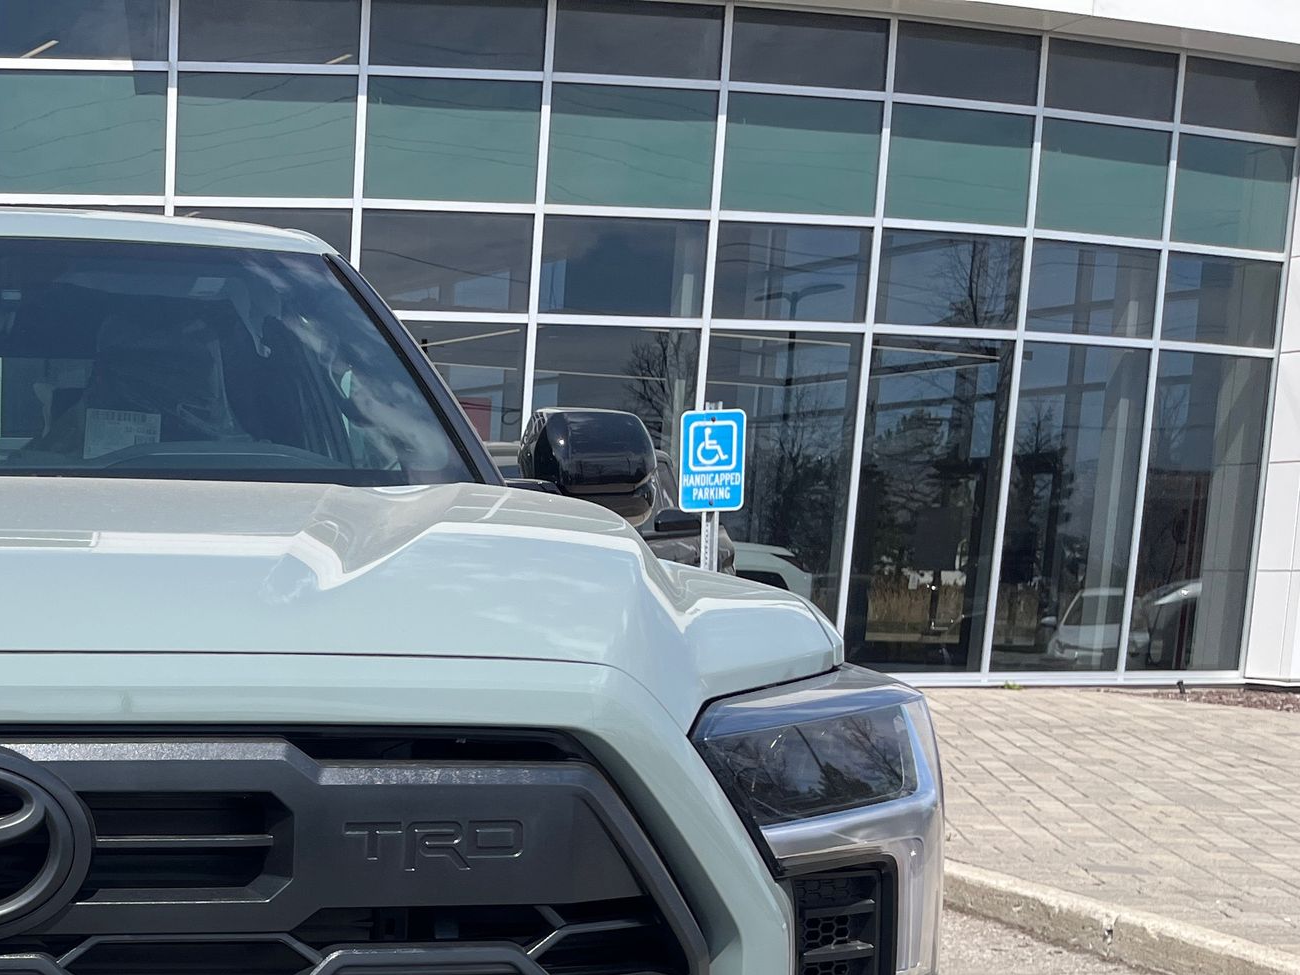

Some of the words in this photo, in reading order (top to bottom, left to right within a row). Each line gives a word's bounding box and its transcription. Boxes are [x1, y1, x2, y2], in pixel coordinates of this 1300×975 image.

[683, 472, 741, 487] HANDICAPPED
[692, 487, 731, 501] PARKING
[343, 820, 524, 871] TRD
